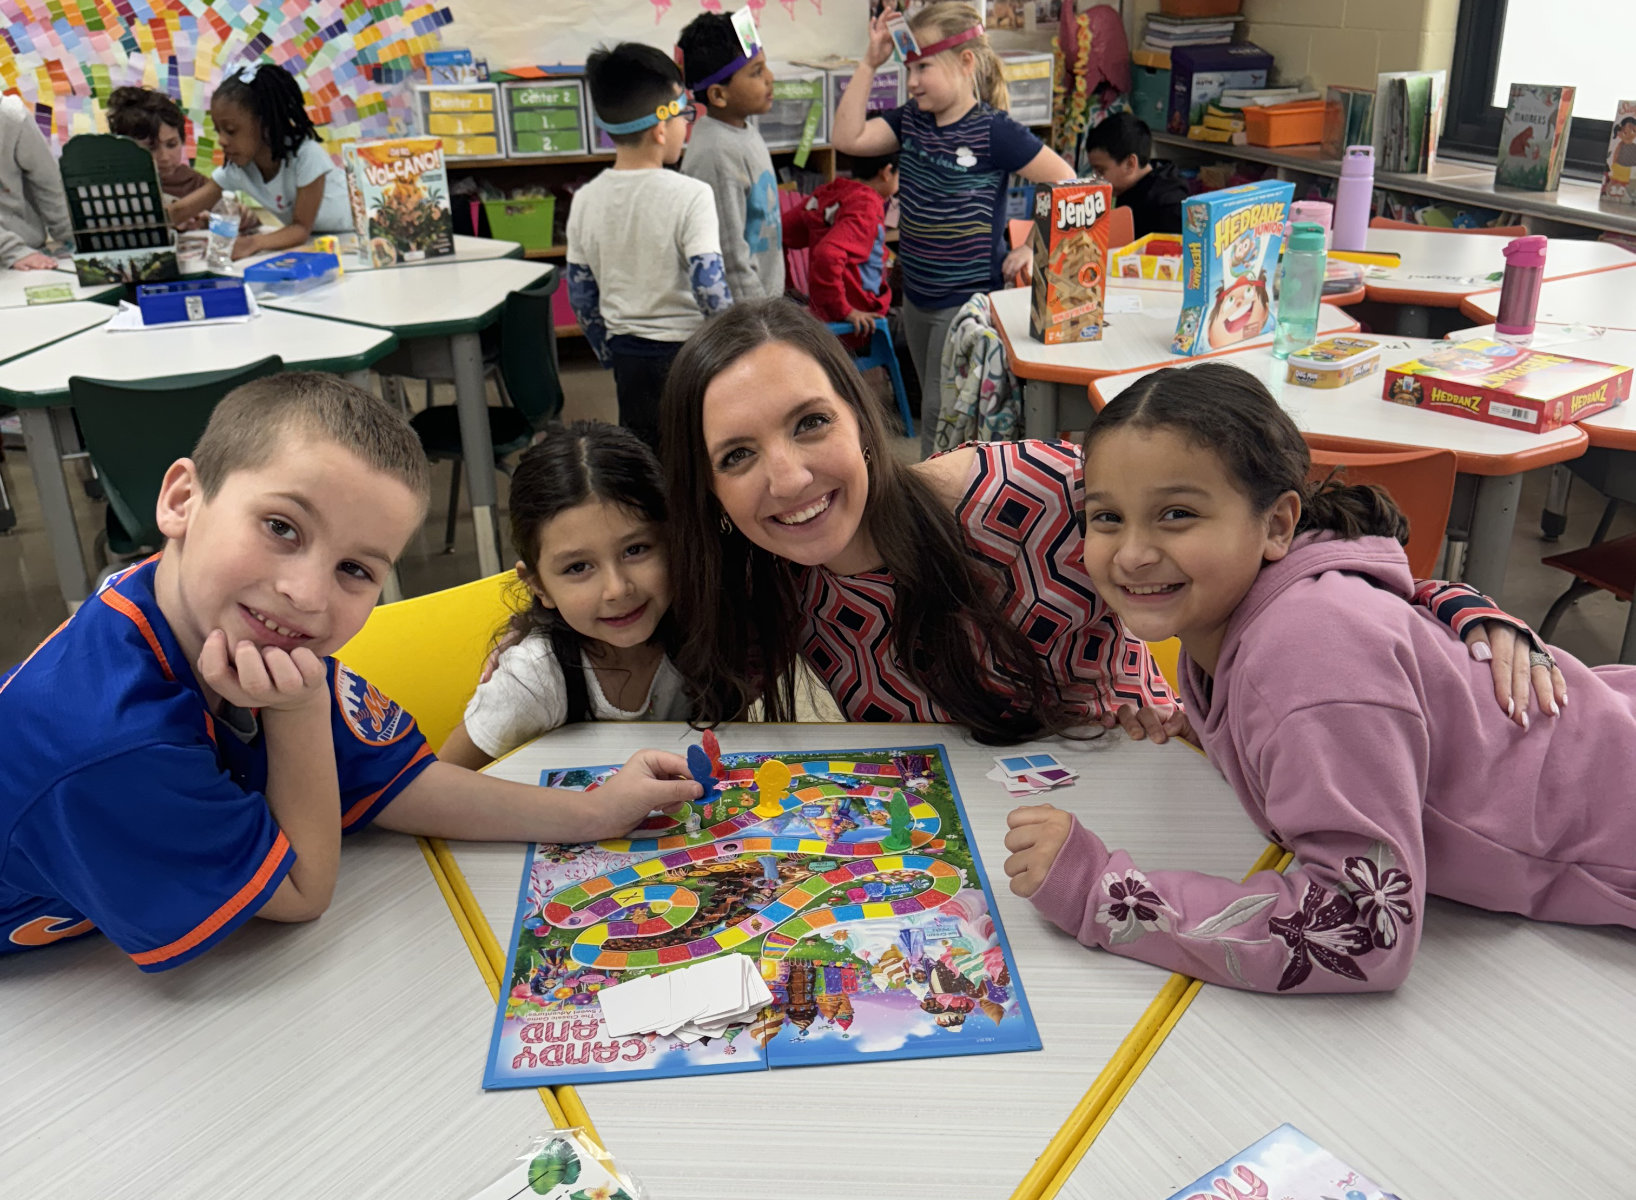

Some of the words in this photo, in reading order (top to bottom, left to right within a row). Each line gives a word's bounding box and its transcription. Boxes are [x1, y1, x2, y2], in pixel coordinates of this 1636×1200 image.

[433, 96, 473, 108] Center
[478, 97, 484, 108] 1
[519, 93, 559, 104] Center
[564, 92, 571, 103] 2
[542, 137, 558, 151] 2.
[365, 148, 443, 186] VOLCANO!
[1057, 190, 1106, 229] Jenga
[1214, 202, 1285, 259] HEDBANZ
[1253, 222, 1285, 238] JUNIOR
[1430, 387, 1482, 412] HEDBANZ
[1570, 383, 1608, 412] HEDBANZ
[519, 1018, 606, 1044] AND
[512, 1039, 647, 1070] CANDY
